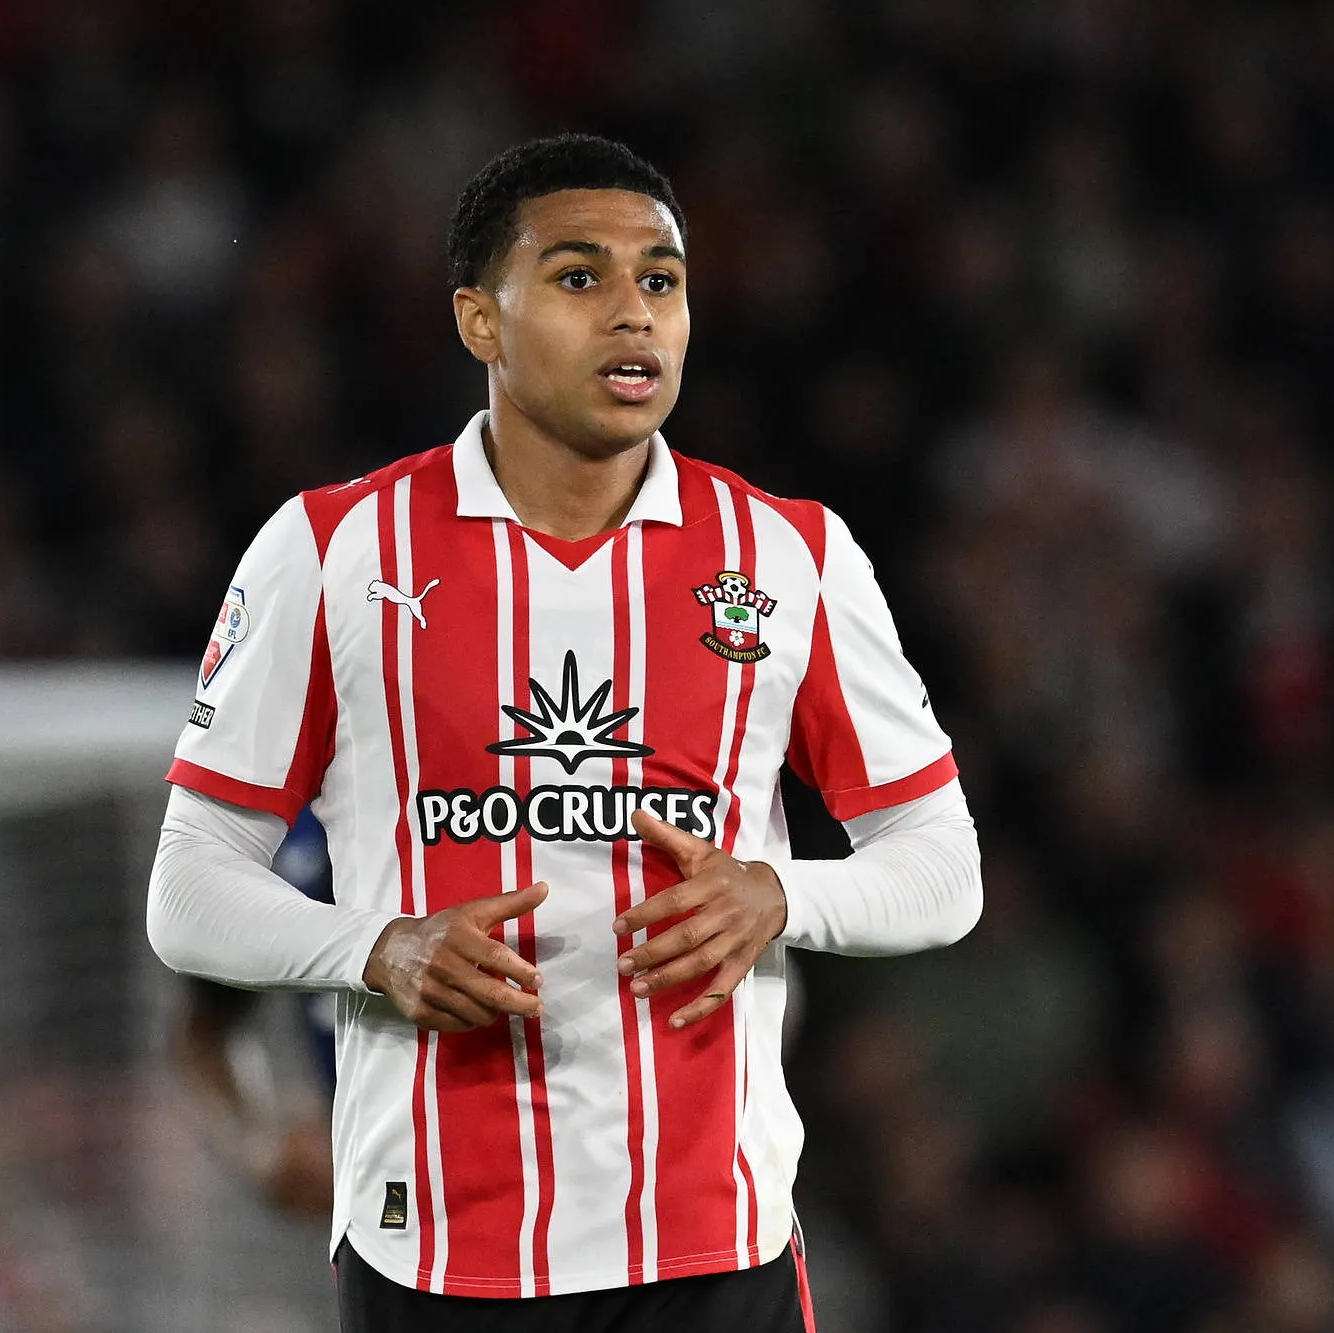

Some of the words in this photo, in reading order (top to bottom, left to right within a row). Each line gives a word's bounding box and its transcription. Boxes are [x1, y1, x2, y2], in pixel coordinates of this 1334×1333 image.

[227, 628, 237, 640] EFL
[705, 636, 756, 660] SOUTHAMPTON
[757, 646, 766, 658] FC
[190, 702, 214, 726] THER
[421, 791, 517, 840] P&O
